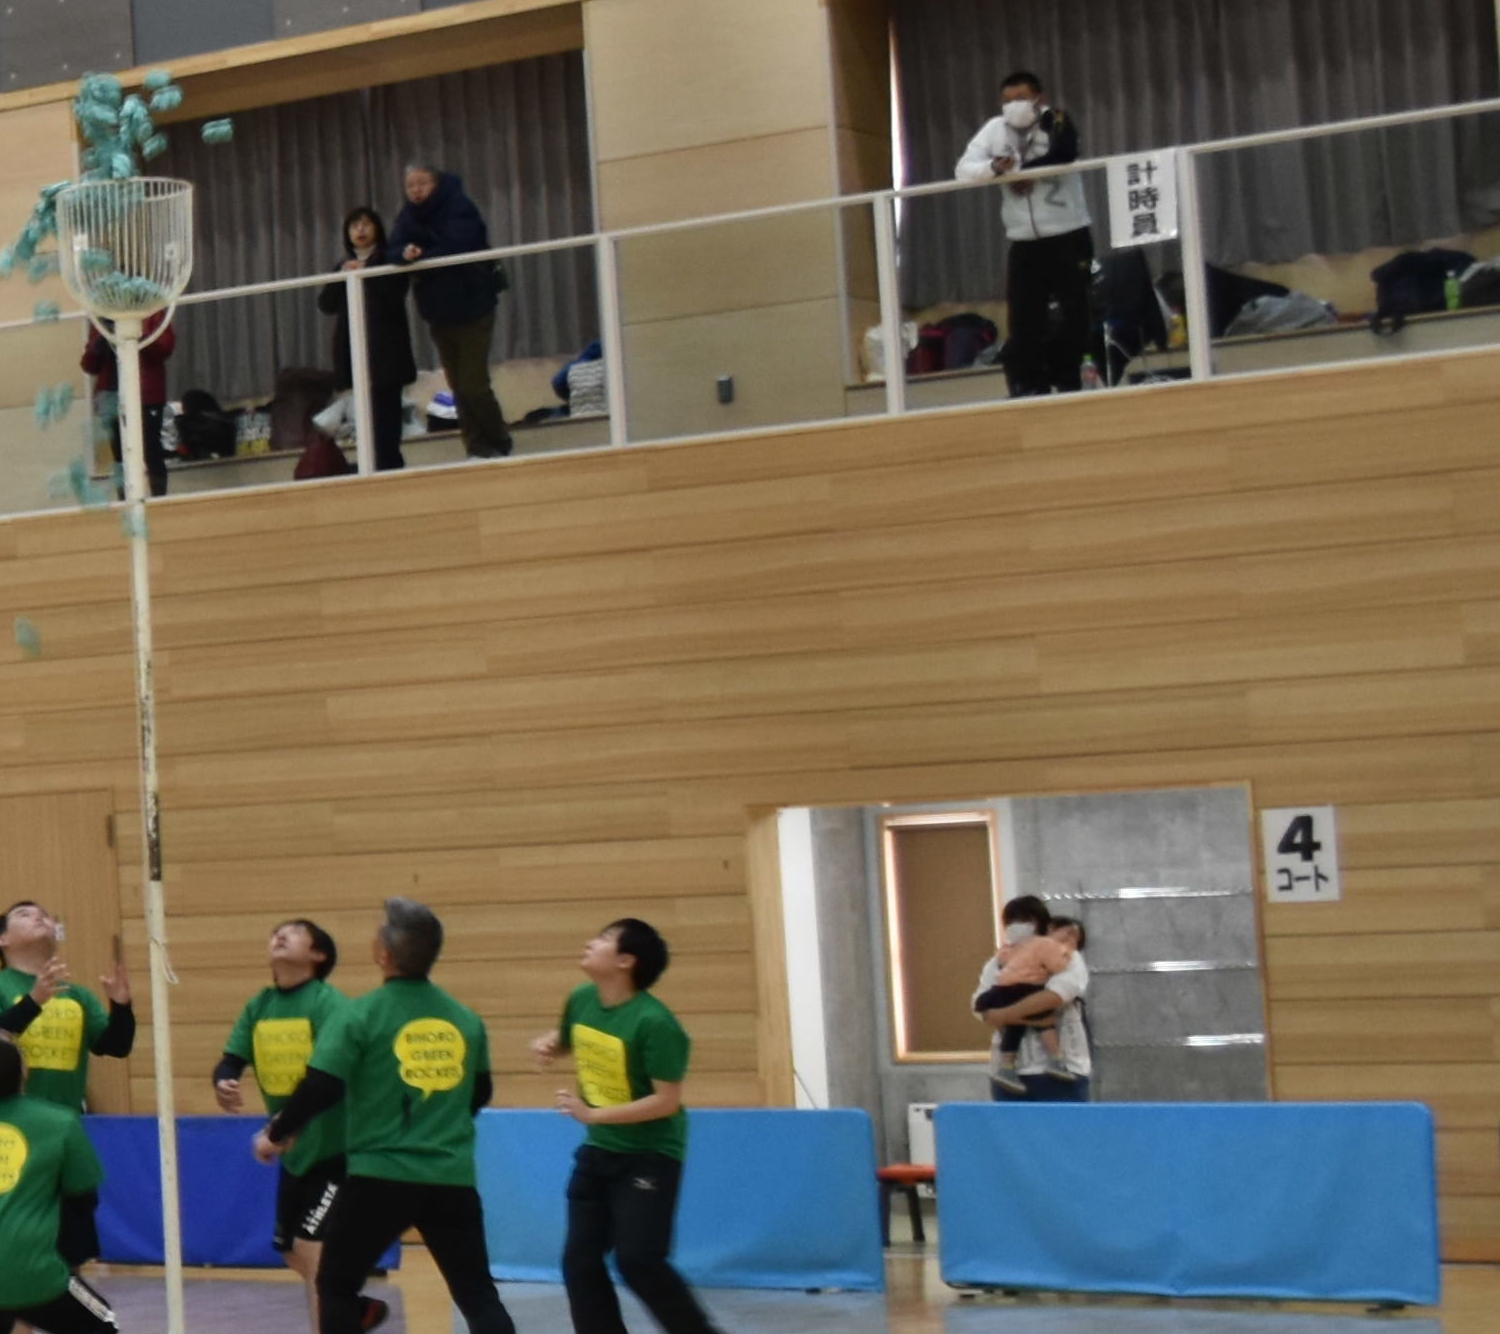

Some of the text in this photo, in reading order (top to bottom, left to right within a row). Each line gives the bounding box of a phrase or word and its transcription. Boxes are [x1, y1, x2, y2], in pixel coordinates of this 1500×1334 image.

[1127, 160, 1159, 238] 計時員
[1276, 814, 1322, 862] 4
[1277, 865, 1329, 892] コート
